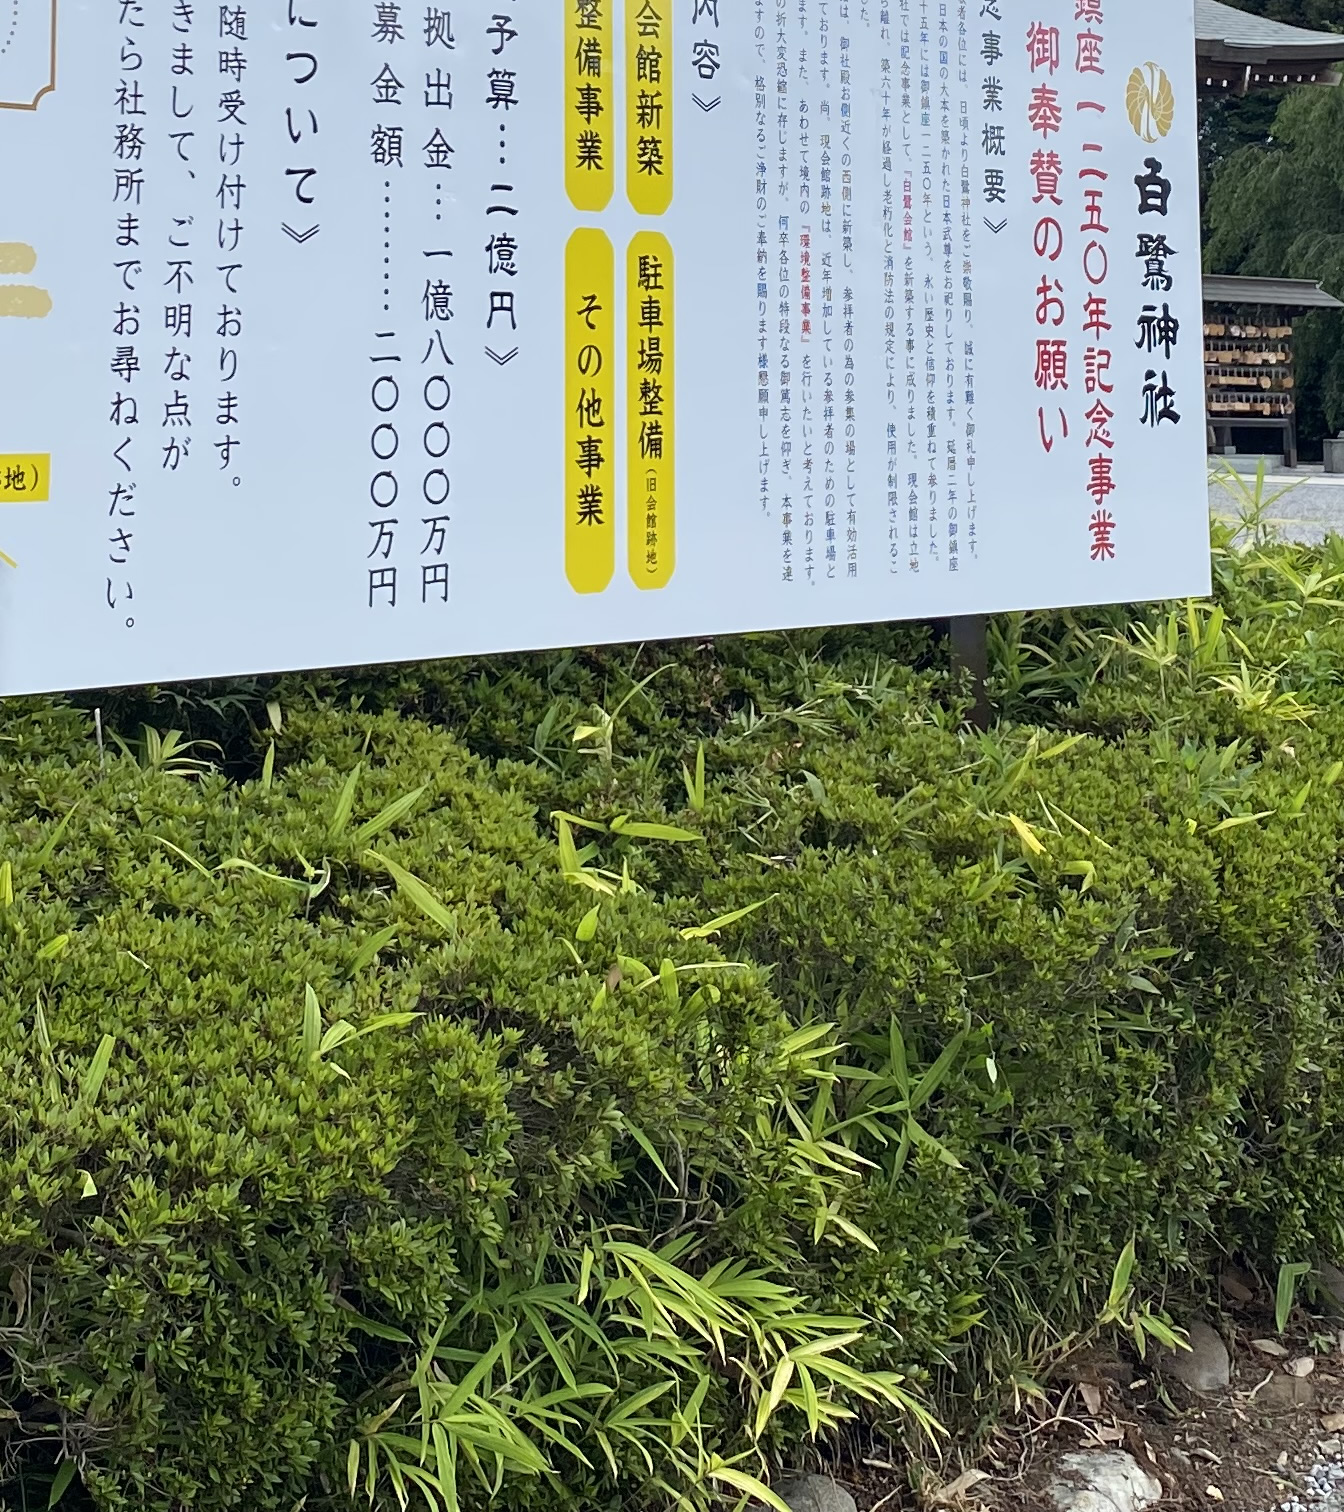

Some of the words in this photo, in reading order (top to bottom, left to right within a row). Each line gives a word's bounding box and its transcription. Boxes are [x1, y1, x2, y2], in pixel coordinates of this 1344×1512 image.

[1026, 21, 1068, 453] 御奉賛のお願い
[1134, 157, 1180, 428] 白鷺神社
[575, 294, 605, 526] その他事業
